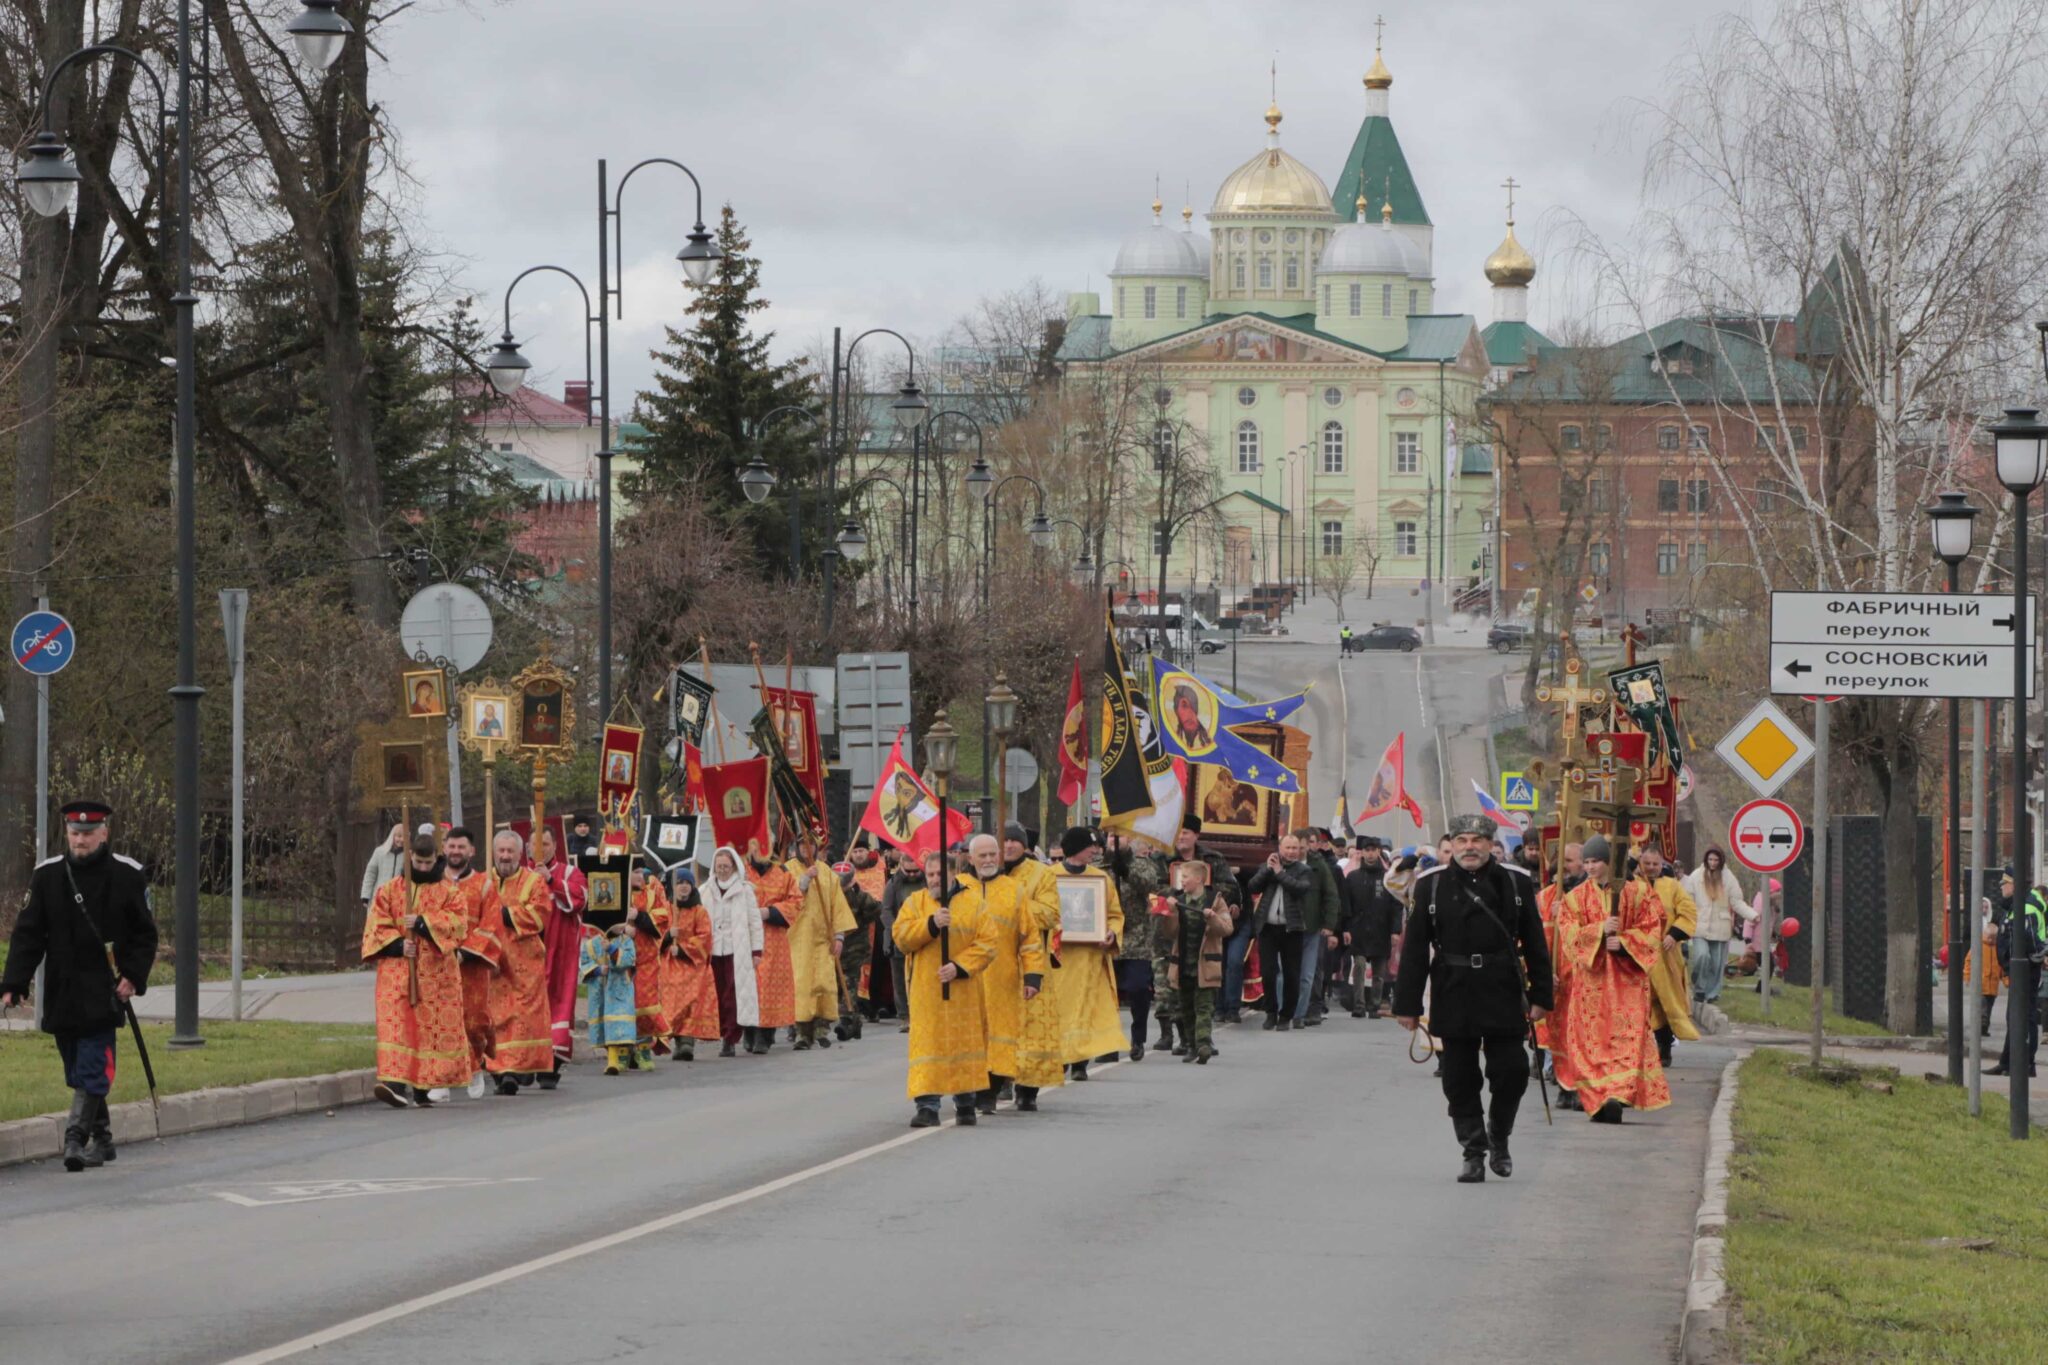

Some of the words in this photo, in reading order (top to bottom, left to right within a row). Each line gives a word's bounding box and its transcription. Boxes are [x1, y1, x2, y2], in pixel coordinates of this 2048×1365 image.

[1826, 599, 1980, 616] ФАБРИЧНЫЙ
[1826, 624, 1930, 639] переулок
[1825, 650, 1988, 667] СОСНОВСКИЙ
[1825, 675, 1929, 690] переулок
